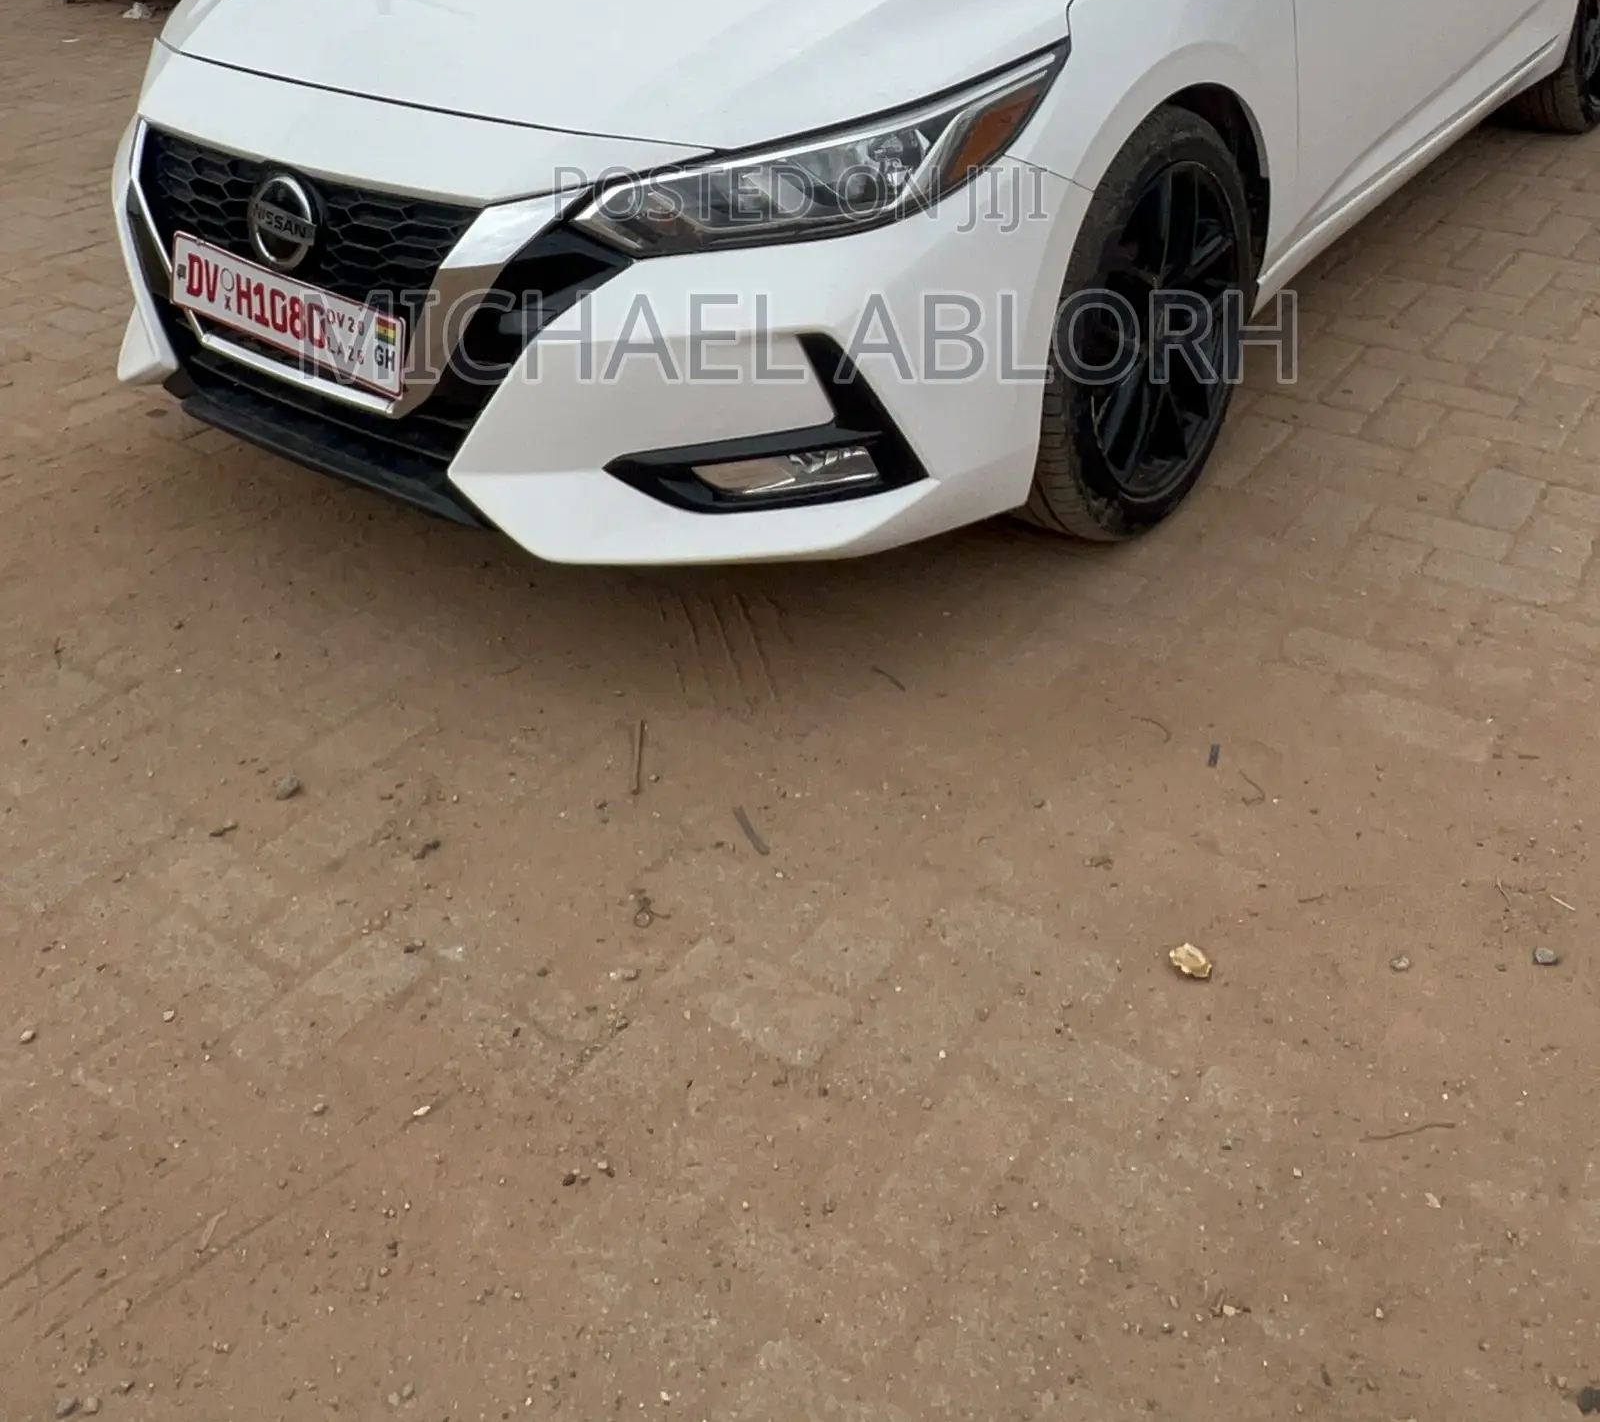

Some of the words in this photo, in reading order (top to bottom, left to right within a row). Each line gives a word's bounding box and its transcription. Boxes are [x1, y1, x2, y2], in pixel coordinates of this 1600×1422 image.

[252, 203, 307, 238] NISSAN
[186, 253, 219, 303] DV
[374, 345, 396, 371] GH
